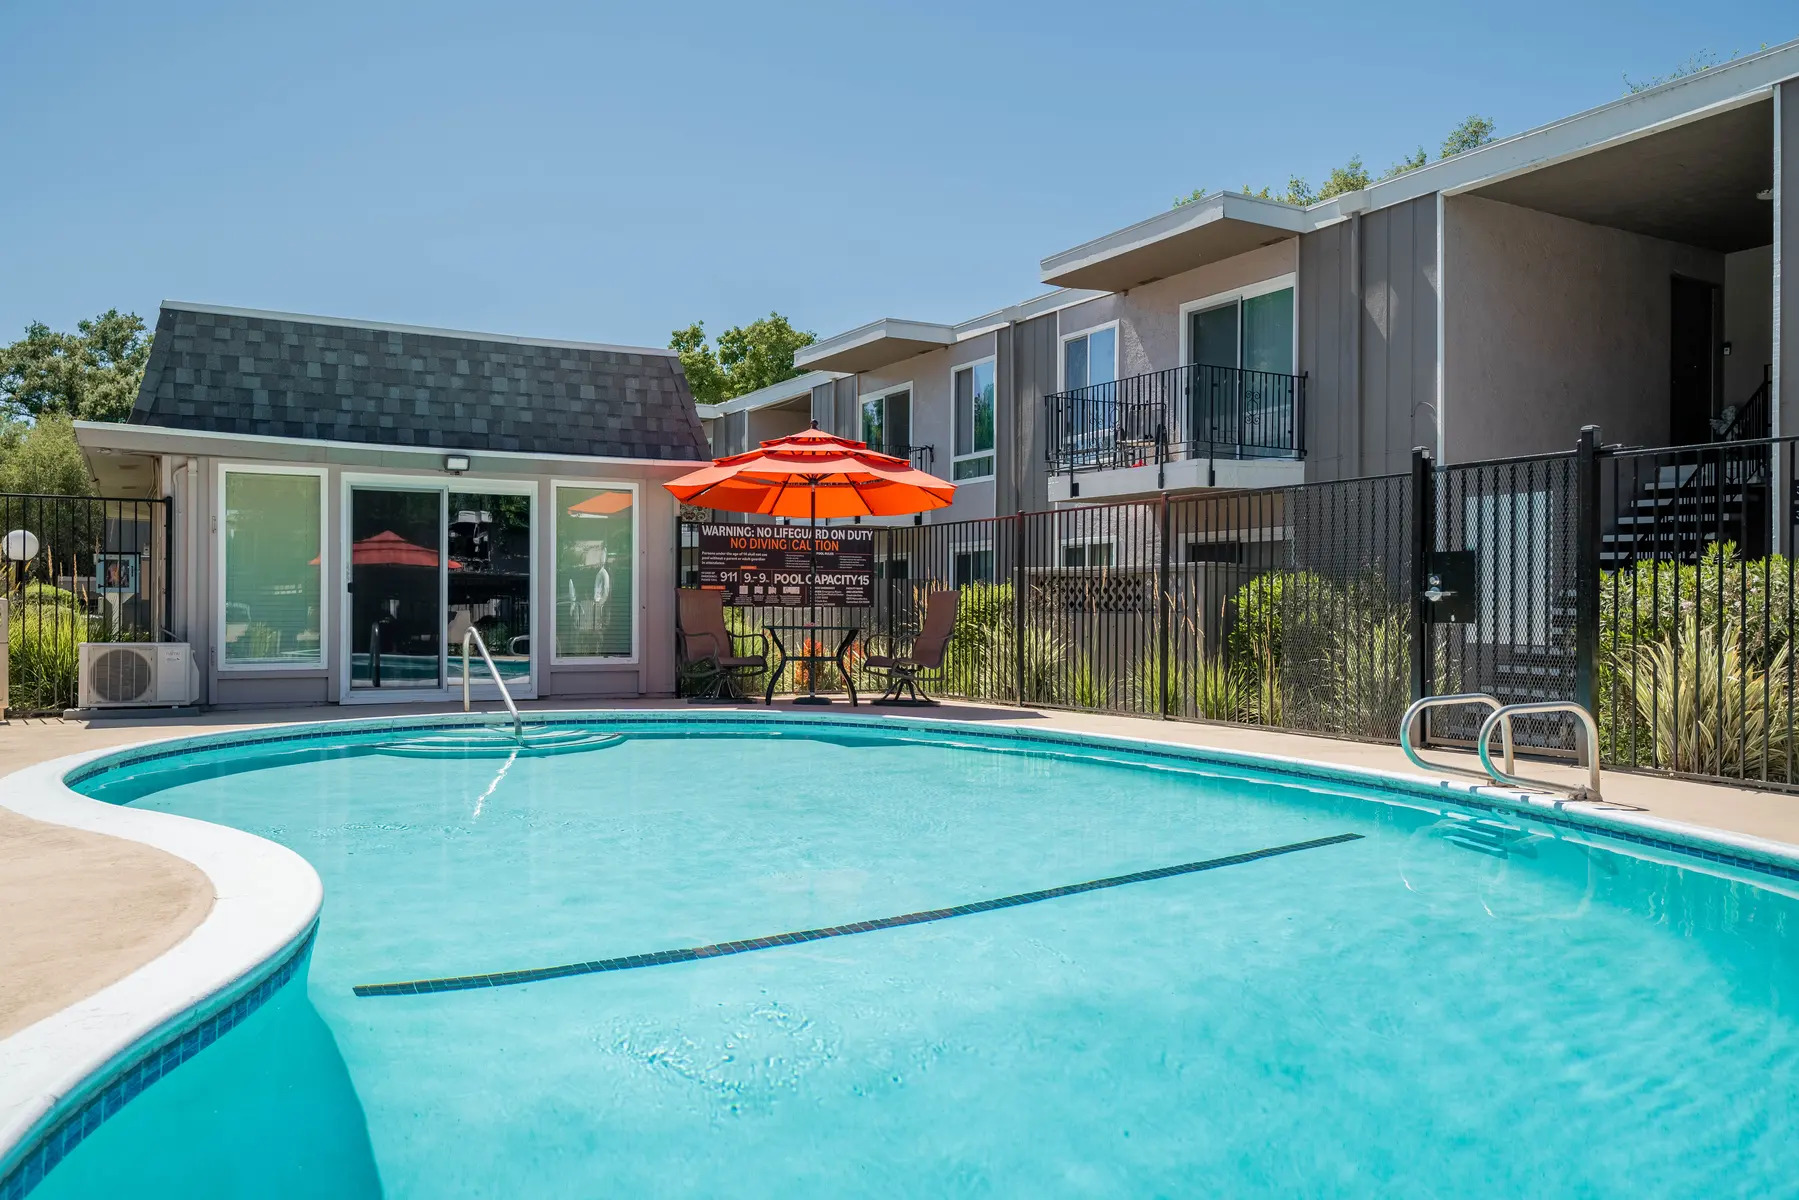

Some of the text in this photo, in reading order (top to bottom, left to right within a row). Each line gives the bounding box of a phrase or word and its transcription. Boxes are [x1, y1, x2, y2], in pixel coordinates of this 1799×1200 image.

[701, 525, 755, 537] WARNING:
[756, 526, 772, 538] NO
[830, 529, 846, 540] ON
[847, 530, 873, 541] DUTY
[730, 537, 747, 549] NO
[749, 538, 787, 550] DIVING
[720, 571, 738, 582] 911
[774, 573, 804, 584] POOL
[858, 574, 870, 585] 15
